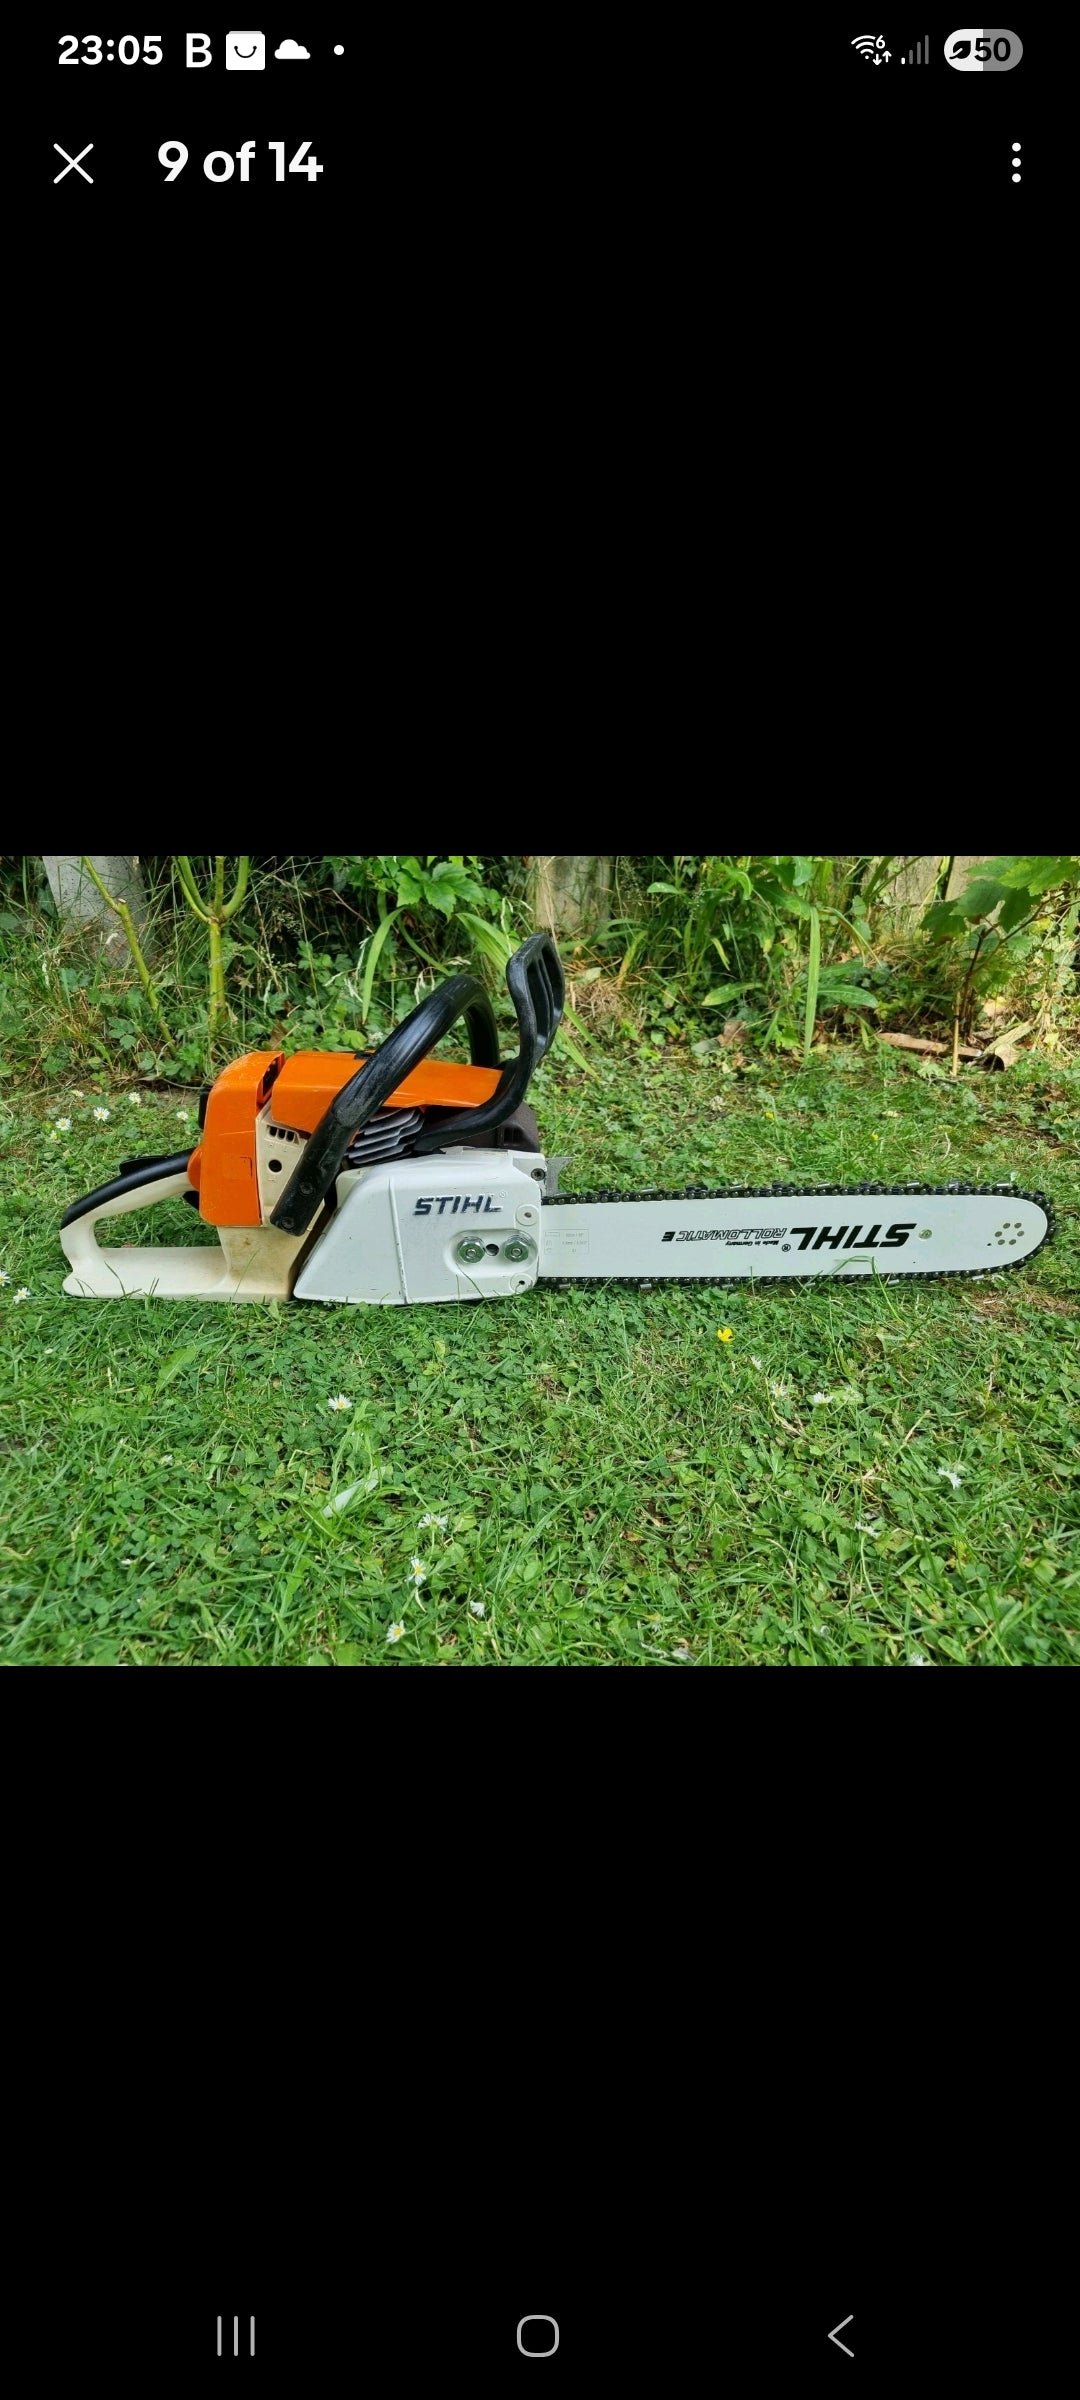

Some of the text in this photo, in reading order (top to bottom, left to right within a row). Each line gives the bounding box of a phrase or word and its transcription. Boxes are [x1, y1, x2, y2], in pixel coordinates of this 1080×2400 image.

[413, 1195, 502, 1215] STIHL
[661, 1223, 917, 1250] STIHL ROLLOMATIC E
